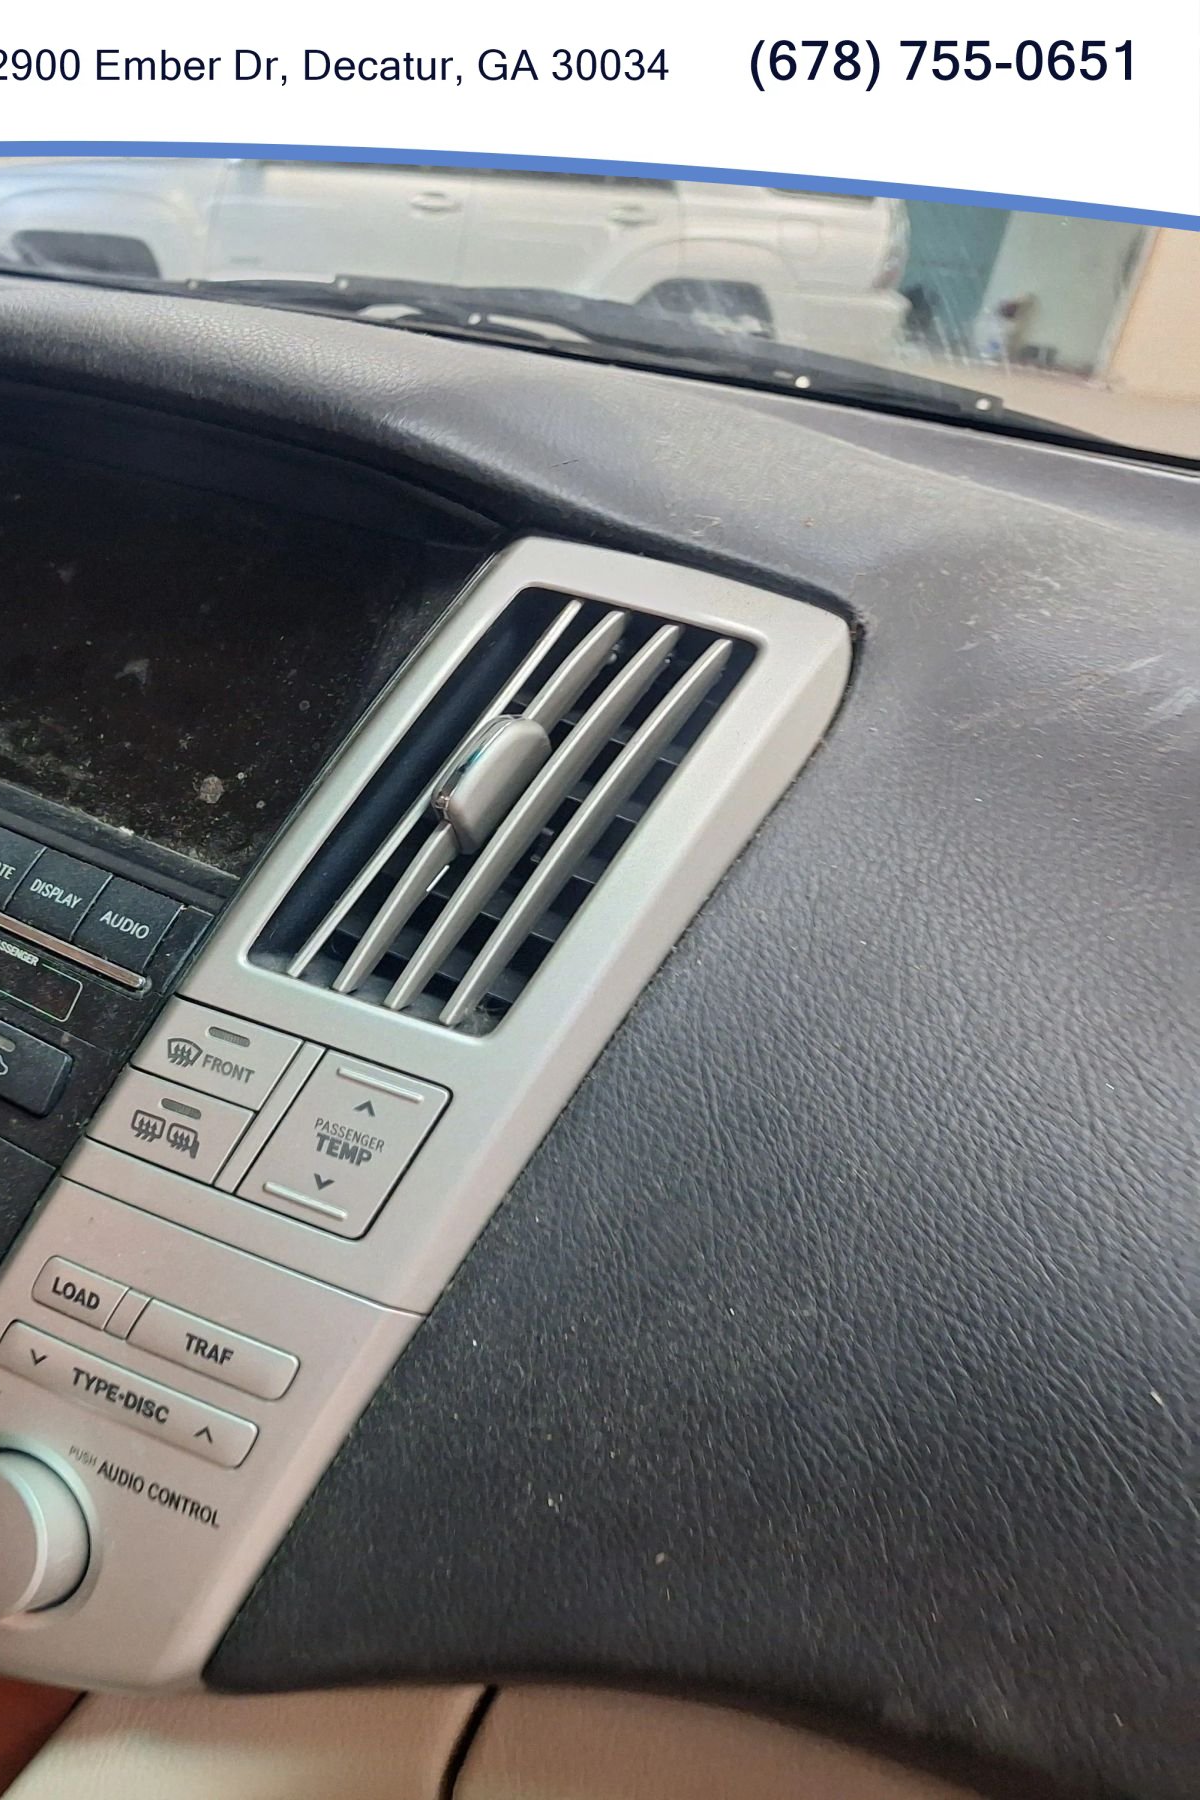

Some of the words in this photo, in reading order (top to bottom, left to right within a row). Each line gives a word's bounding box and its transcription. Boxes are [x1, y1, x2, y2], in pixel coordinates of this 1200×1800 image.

[30, 878, 83, 910] DISPLAY
[99, 909, 150, 939] AUDIO
[202, 1053, 255, 1084] FRONT
[314, 1117, 385, 1153] PASSENGER
[315, 1132, 373, 1167] TEMP
[51, 1275, 101, 1311] LOAD
[184, 1332, 235, 1366] TRAF
[69, 1445, 98, 1467] PUSH
[97, 1459, 146, 1496] AUDIO
[147, 1481, 220, 1529] CONTROL
